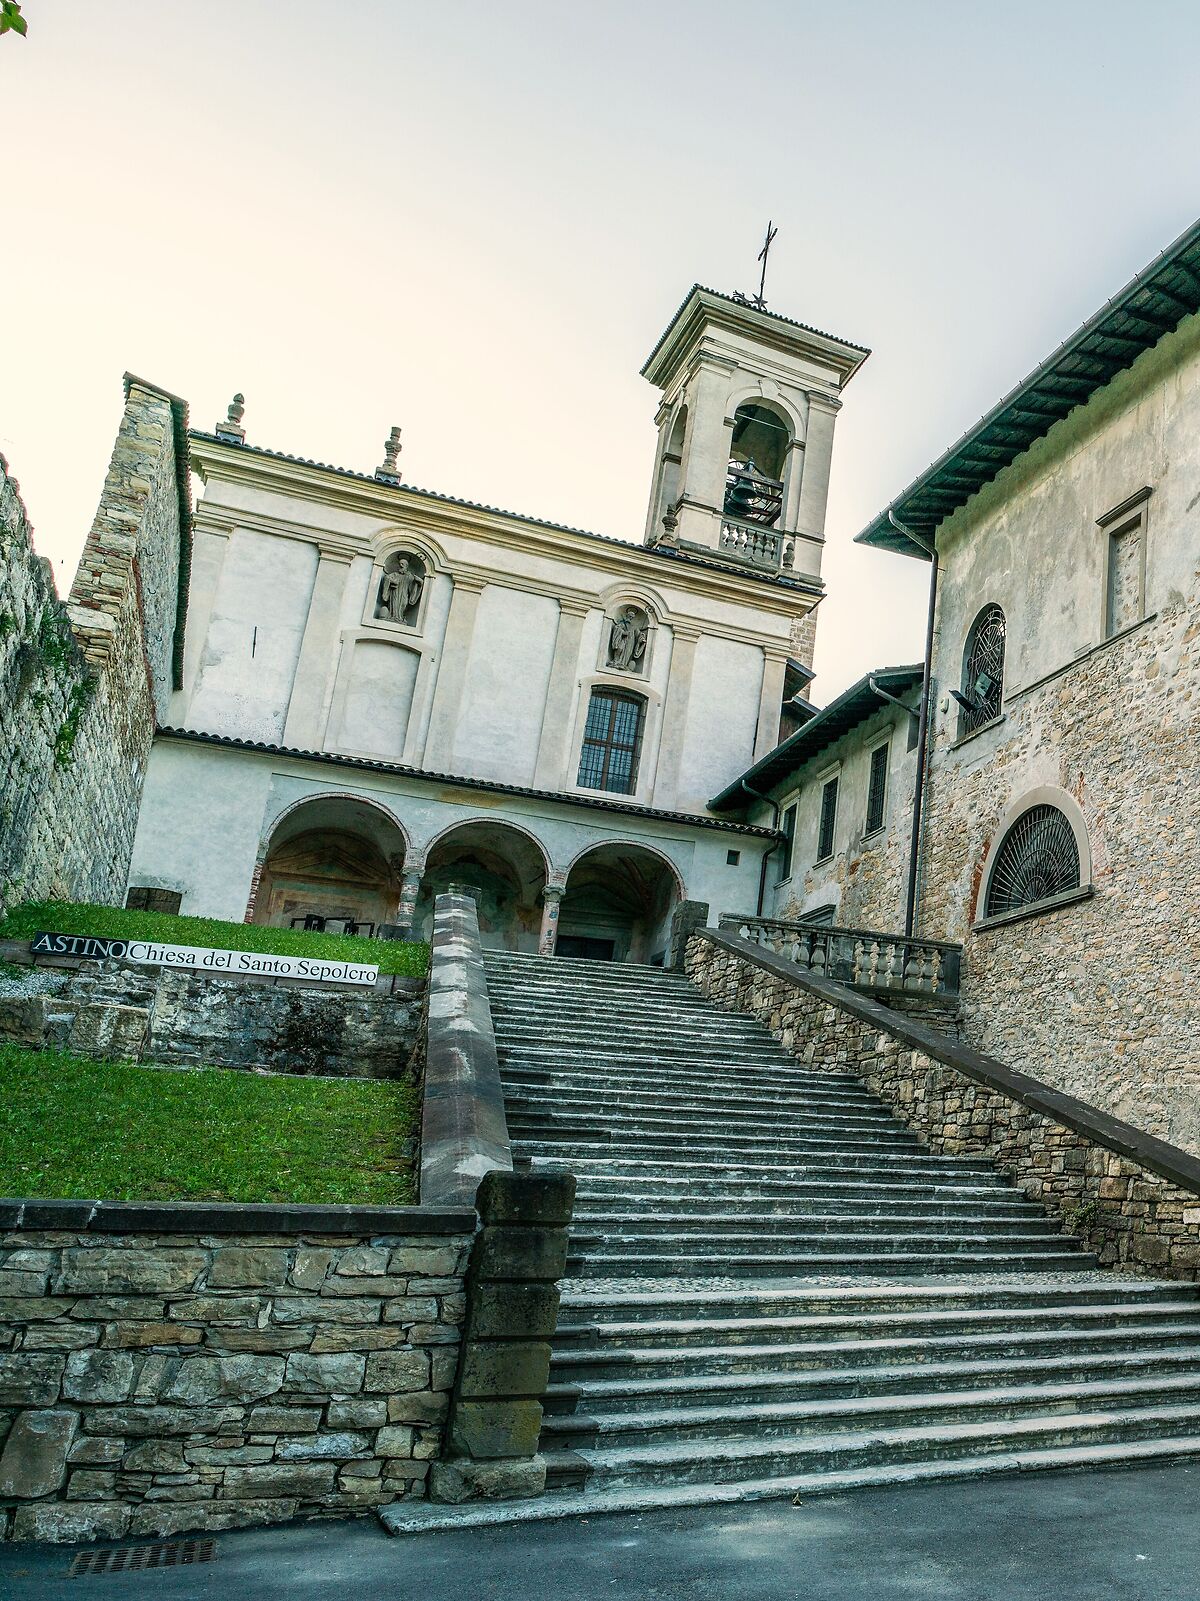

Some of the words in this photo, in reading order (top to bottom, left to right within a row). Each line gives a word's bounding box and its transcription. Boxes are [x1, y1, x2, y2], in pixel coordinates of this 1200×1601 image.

[32, 934, 128, 958] ASTINO
[129, 943, 196, 965] Chiesa
[202, 951, 232, 968] del
[238, 954, 291, 974] Santo
[297, 960, 377, 982] Sepolcro
